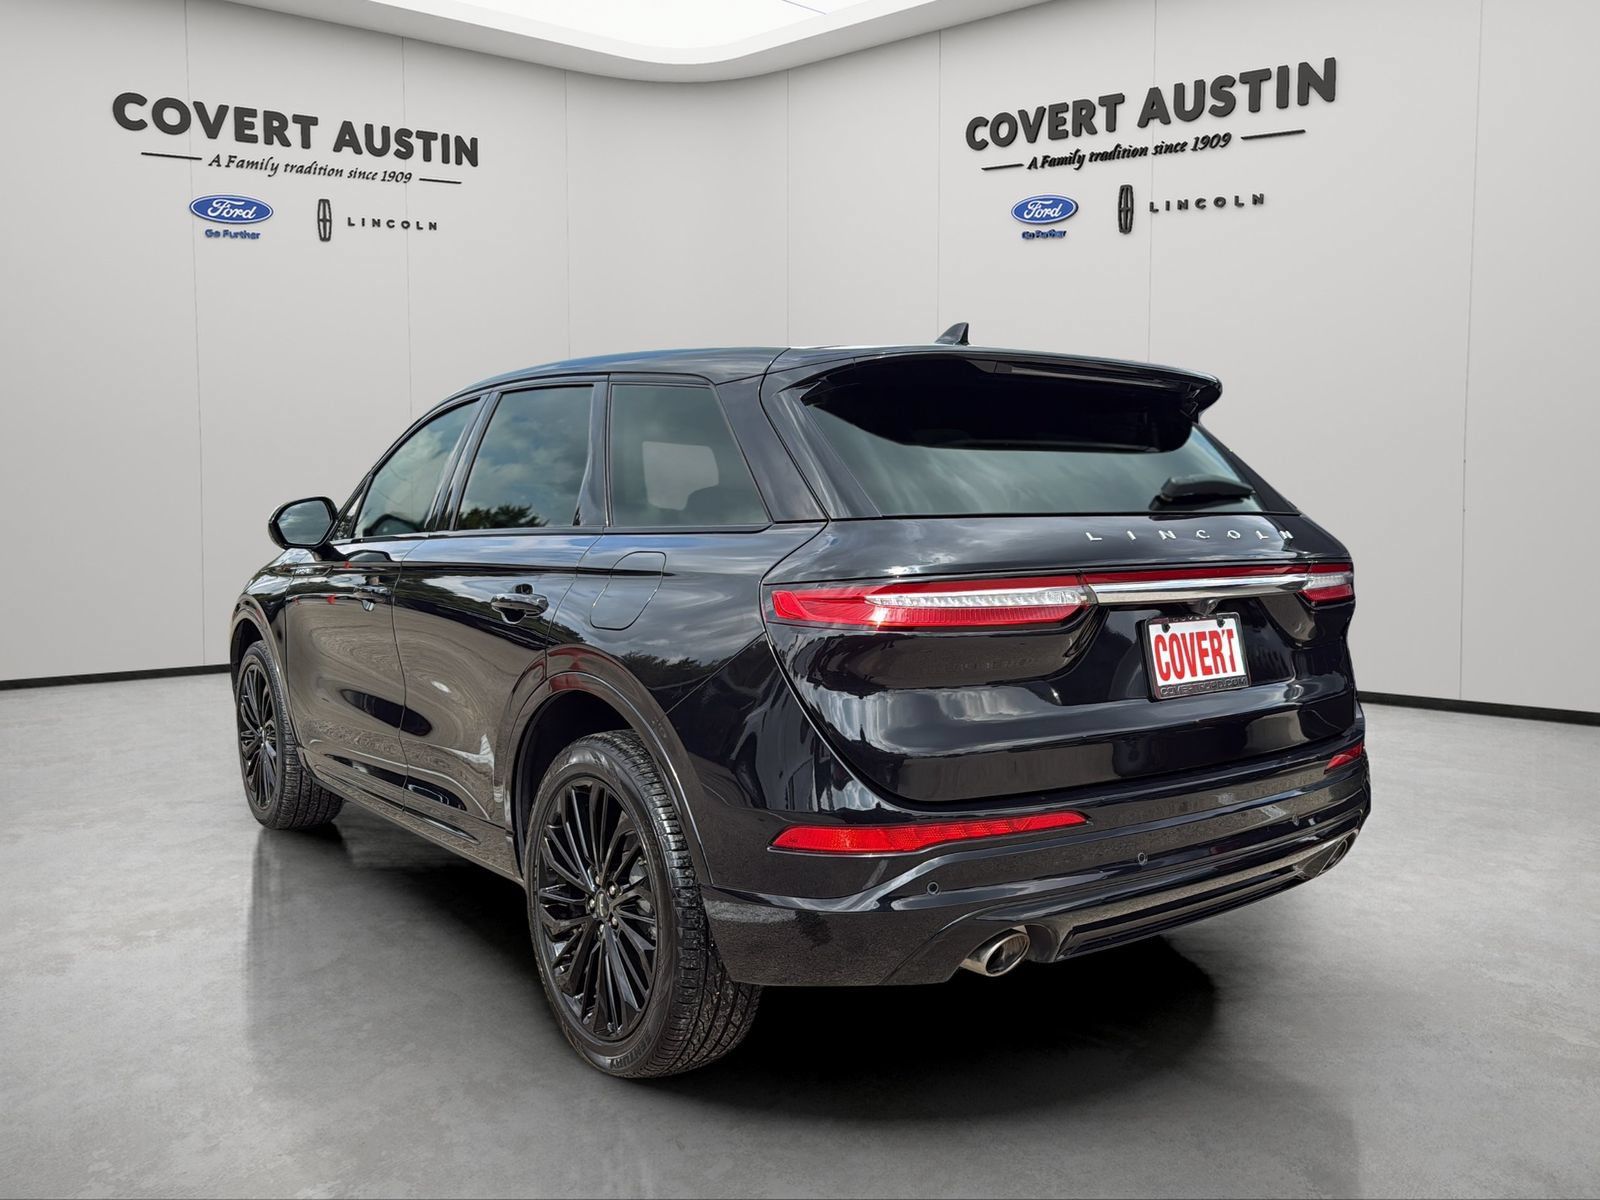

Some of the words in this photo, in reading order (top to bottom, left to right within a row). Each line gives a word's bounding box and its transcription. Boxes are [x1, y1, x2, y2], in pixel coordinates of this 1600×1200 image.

[964, 92, 1126, 152] COVERT
[1136, 56, 1337, 129] AUSTIN
[112, 92, 319, 150] COVERT
[332, 120, 479, 168] AUSTIN
[1026, 156, 1039, 171] A
[1039, 148, 1087, 171] Family
[1088, 143, 1149, 163] tradition
[1151, 141, 1189, 156] since
[1190, 132, 1232, 152] 1909
[207, 153, 222, 168] A
[224, 154, 280, 178] Family
[283, 160, 344, 178] tradition
[347, 167, 378, 181] since
[380, 170, 413, 184] 1909
[207, 198, 258, 219] Ford
[1023, 200, 1063, 219] Ford
[1149, 193, 1265, 214] LINCOLN
[347, 216, 437, 231] LINCOLN
[222, 229, 261, 240] Further
[1085, 529, 1294, 542] LINCOLN
